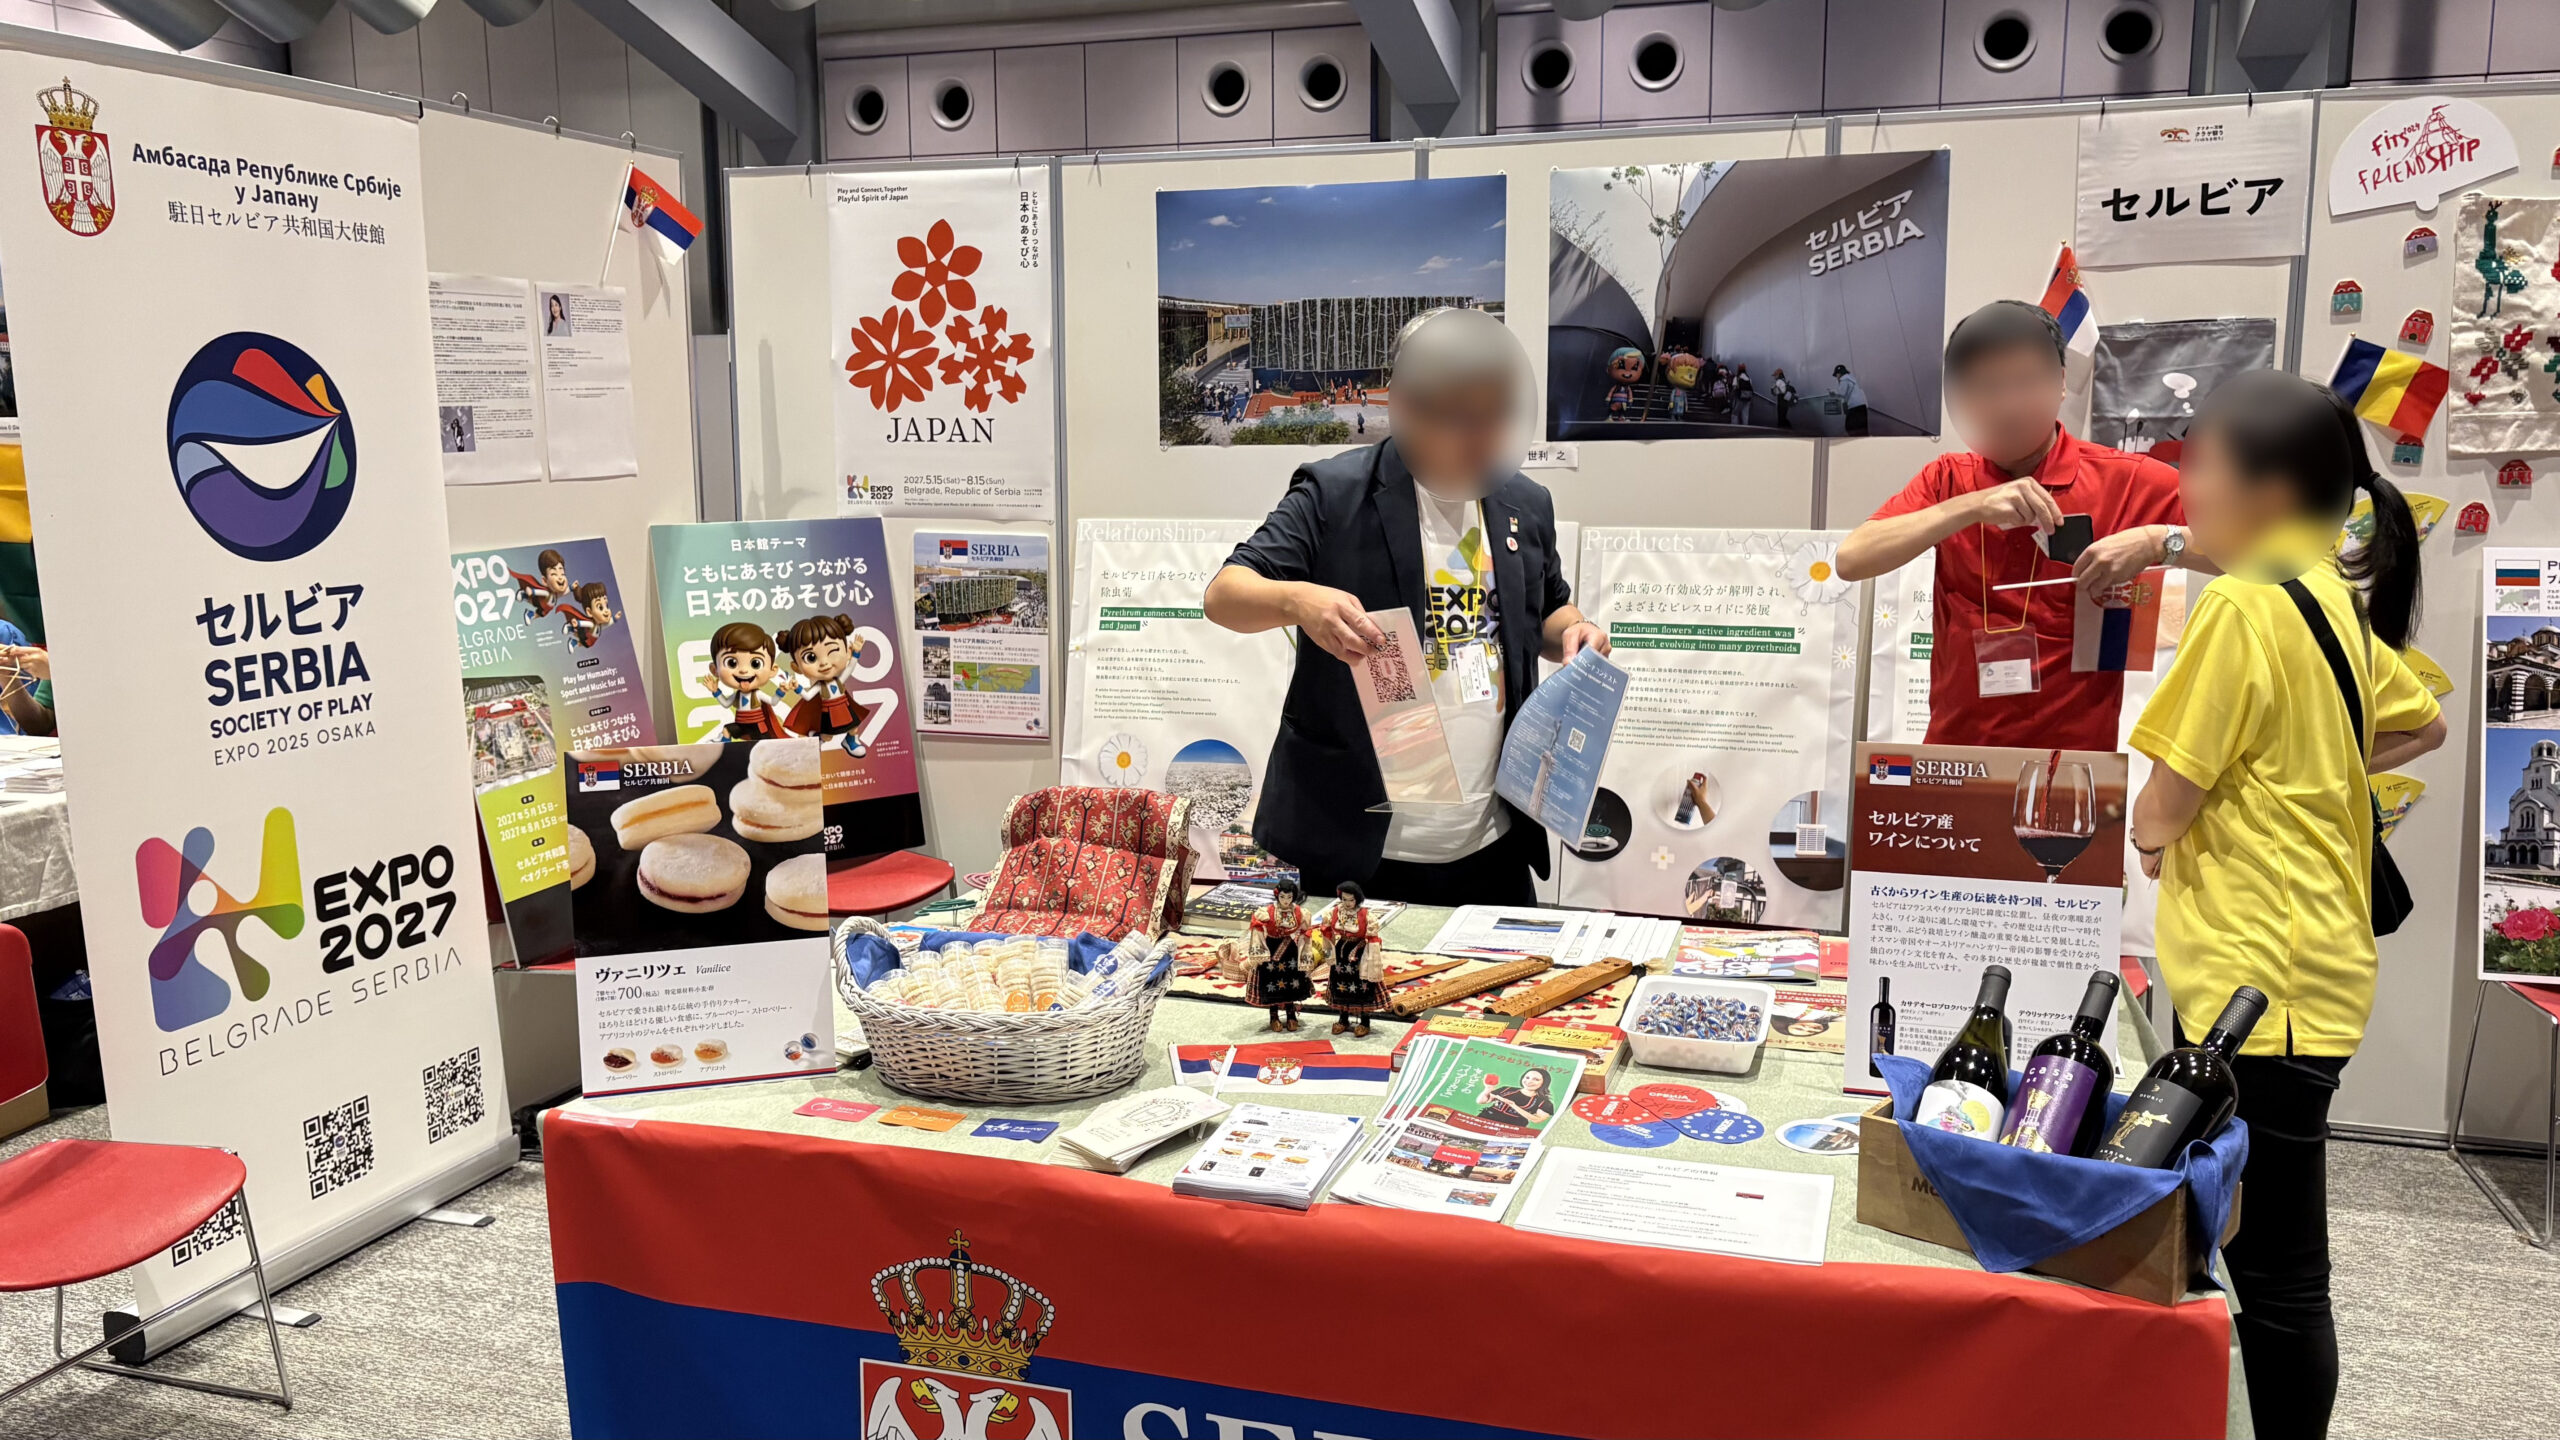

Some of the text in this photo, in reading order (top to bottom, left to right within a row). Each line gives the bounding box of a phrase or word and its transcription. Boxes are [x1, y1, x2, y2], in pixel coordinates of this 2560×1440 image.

[132, 143, 401, 200] Амбасада Републике Србије
[235, 184, 319, 212] у Јапану
[837, 187, 848, 195] Play
[861, 186, 884, 194] Connect,
[884, 185, 908, 194] Together
[837, 194, 860, 203] Playful
[862, 194, 879, 203] Spirit
[889, 193, 908, 202] Japan
[2102, 177, 2284, 222] セルビア
[169, 200, 386, 245] 駐日セルビア共和国大使館
[1020, 191, 1030, 268] 日本のあそび心
[1805, 189, 1914, 252] セルビア
[1808, 217, 1925, 277] SERBIA
[886, 417, 995, 444] JAPAN
[870, 485, 893, 493] EXPO
[903, 486, 943, 497] Belgrade,
[944, 486, 981, 496] Republic
[983, 486, 992, 496] of
[994, 487, 1021, 496] Serbia
[1077, 520, 1207, 543] Relationship
[1583, 529, 1695, 552] Products
[731, 537, 807, 551] 日本館テーマ
[971, 543, 1020, 557] SERBIA
[451, 554, 510, 590] XPO
[683, 557, 868, 584] ともにあそび つながる
[1100, 570, 1207, 582] セルビアと日本をつなぐ
[685, 579, 874, 617] 日本のあそび心
[1100, 586, 1133, 598] 除虫菊
[1426, 587, 1500, 613] EXPO
[1612, 582, 1787, 599] 除虫菊の有効成分が解明され、
[196, 582, 364, 646] セルビア
[454, 588, 516, 626] 027
[1102, 608, 1201, 618] Pyrethrum connects Serbia
[1613, 600, 1770, 617] さまざまなピレスロイドに発展
[1101, 621, 1137, 631] and Japan
[1612, 623, 1658, 635] Pyrethrum
[1697, 626, 1723, 636] active
[1726, 626, 1772, 639] ingredient
[1775, 629, 1792, 638] was
[1611, 639, 1797, 653] uncovered, evolving into many pyrethroids
[459, 646, 513, 670] ERBIA
[205, 641, 370, 706] SERBIA
[563, 667, 618, 685] Play for Humanity:
[560, 687, 579, 699] Sport
[579, 684, 591, 695] and
[590, 682, 608, 692] Music
[608, 679, 617, 689] for
[617, 677, 626, 686] All
[210, 693, 374, 739] SOCIETY OF PLAY
[569, 712, 637, 738] ともにあそび つながる
[214, 720, 376, 766] EXPO 2025 OSAKA
[572, 725, 641, 751] 日本のあそび心
[623, 760, 694, 778] SERBIA
[1915, 760, 1988, 778] SERBIA
[623, 778, 670, 787] セルビア共和国
[1914, 777, 1963, 786] セルビア共和国
[1868, 810, 1954, 830] セルビア産
[1868, 831, 1982, 853] ワインについて
[313, 844, 454, 923] EXPO
[1870, 885, 2101, 911] 古くからワイン生産の伝統を持つ国、セルビア
[319, 891, 456, 975] 2027
[595, 963, 686, 984] ヴァニリツェ
[695, 963, 731, 975] Vanilice
[617, 986, 642, 1000] 700
[160, 947, 462, 1077] BELGRADE SERBIA
[598, 999, 752, 1018] セルビアで愛され続ける伝統の手作りクッキー。
[599, 1022, 744, 1040] アプリコットのジャムをそれぞれサンドしました。
[2029, 1065, 2074, 1082] casa
